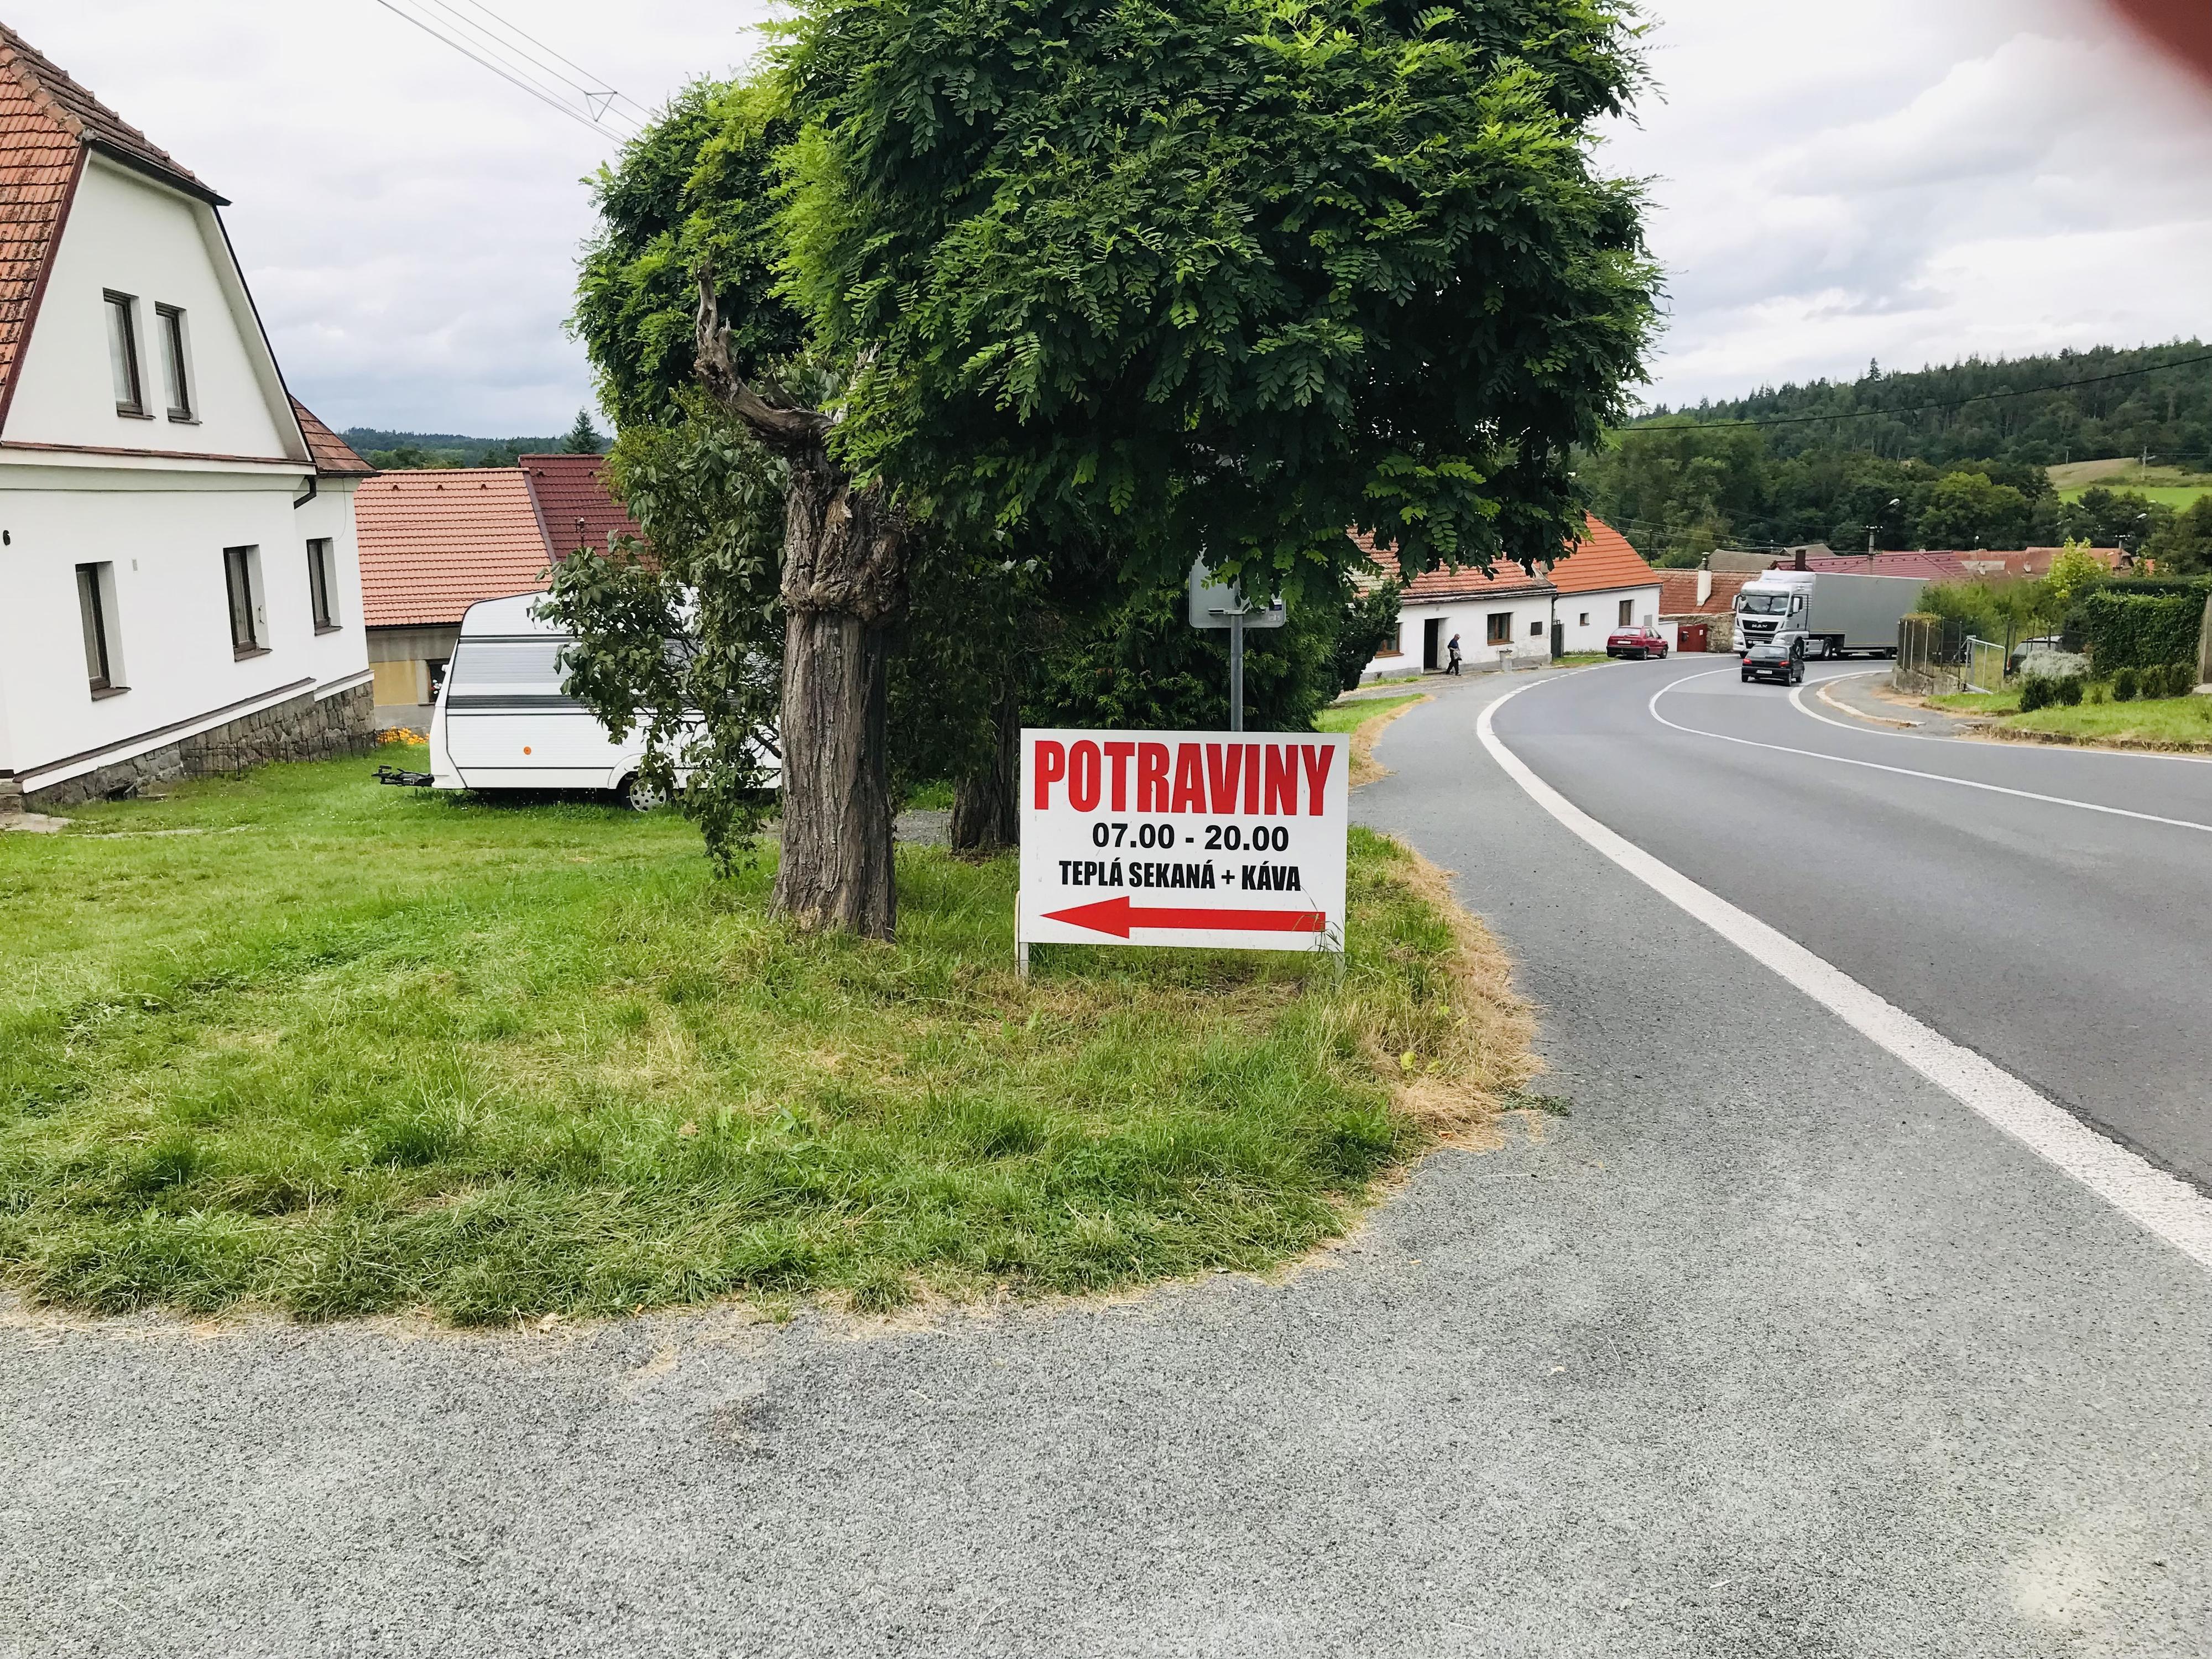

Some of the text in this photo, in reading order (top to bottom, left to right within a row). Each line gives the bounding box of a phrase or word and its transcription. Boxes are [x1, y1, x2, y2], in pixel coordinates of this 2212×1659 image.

[1034, 739, 1335, 816] POTRAVINY
[1092, 822, 1175, 849] 07.00
[1204, 825, 1289, 852] 20.00
[1058, 857, 1301, 891] TEPLÁ SEKANÁ + KÁVA
